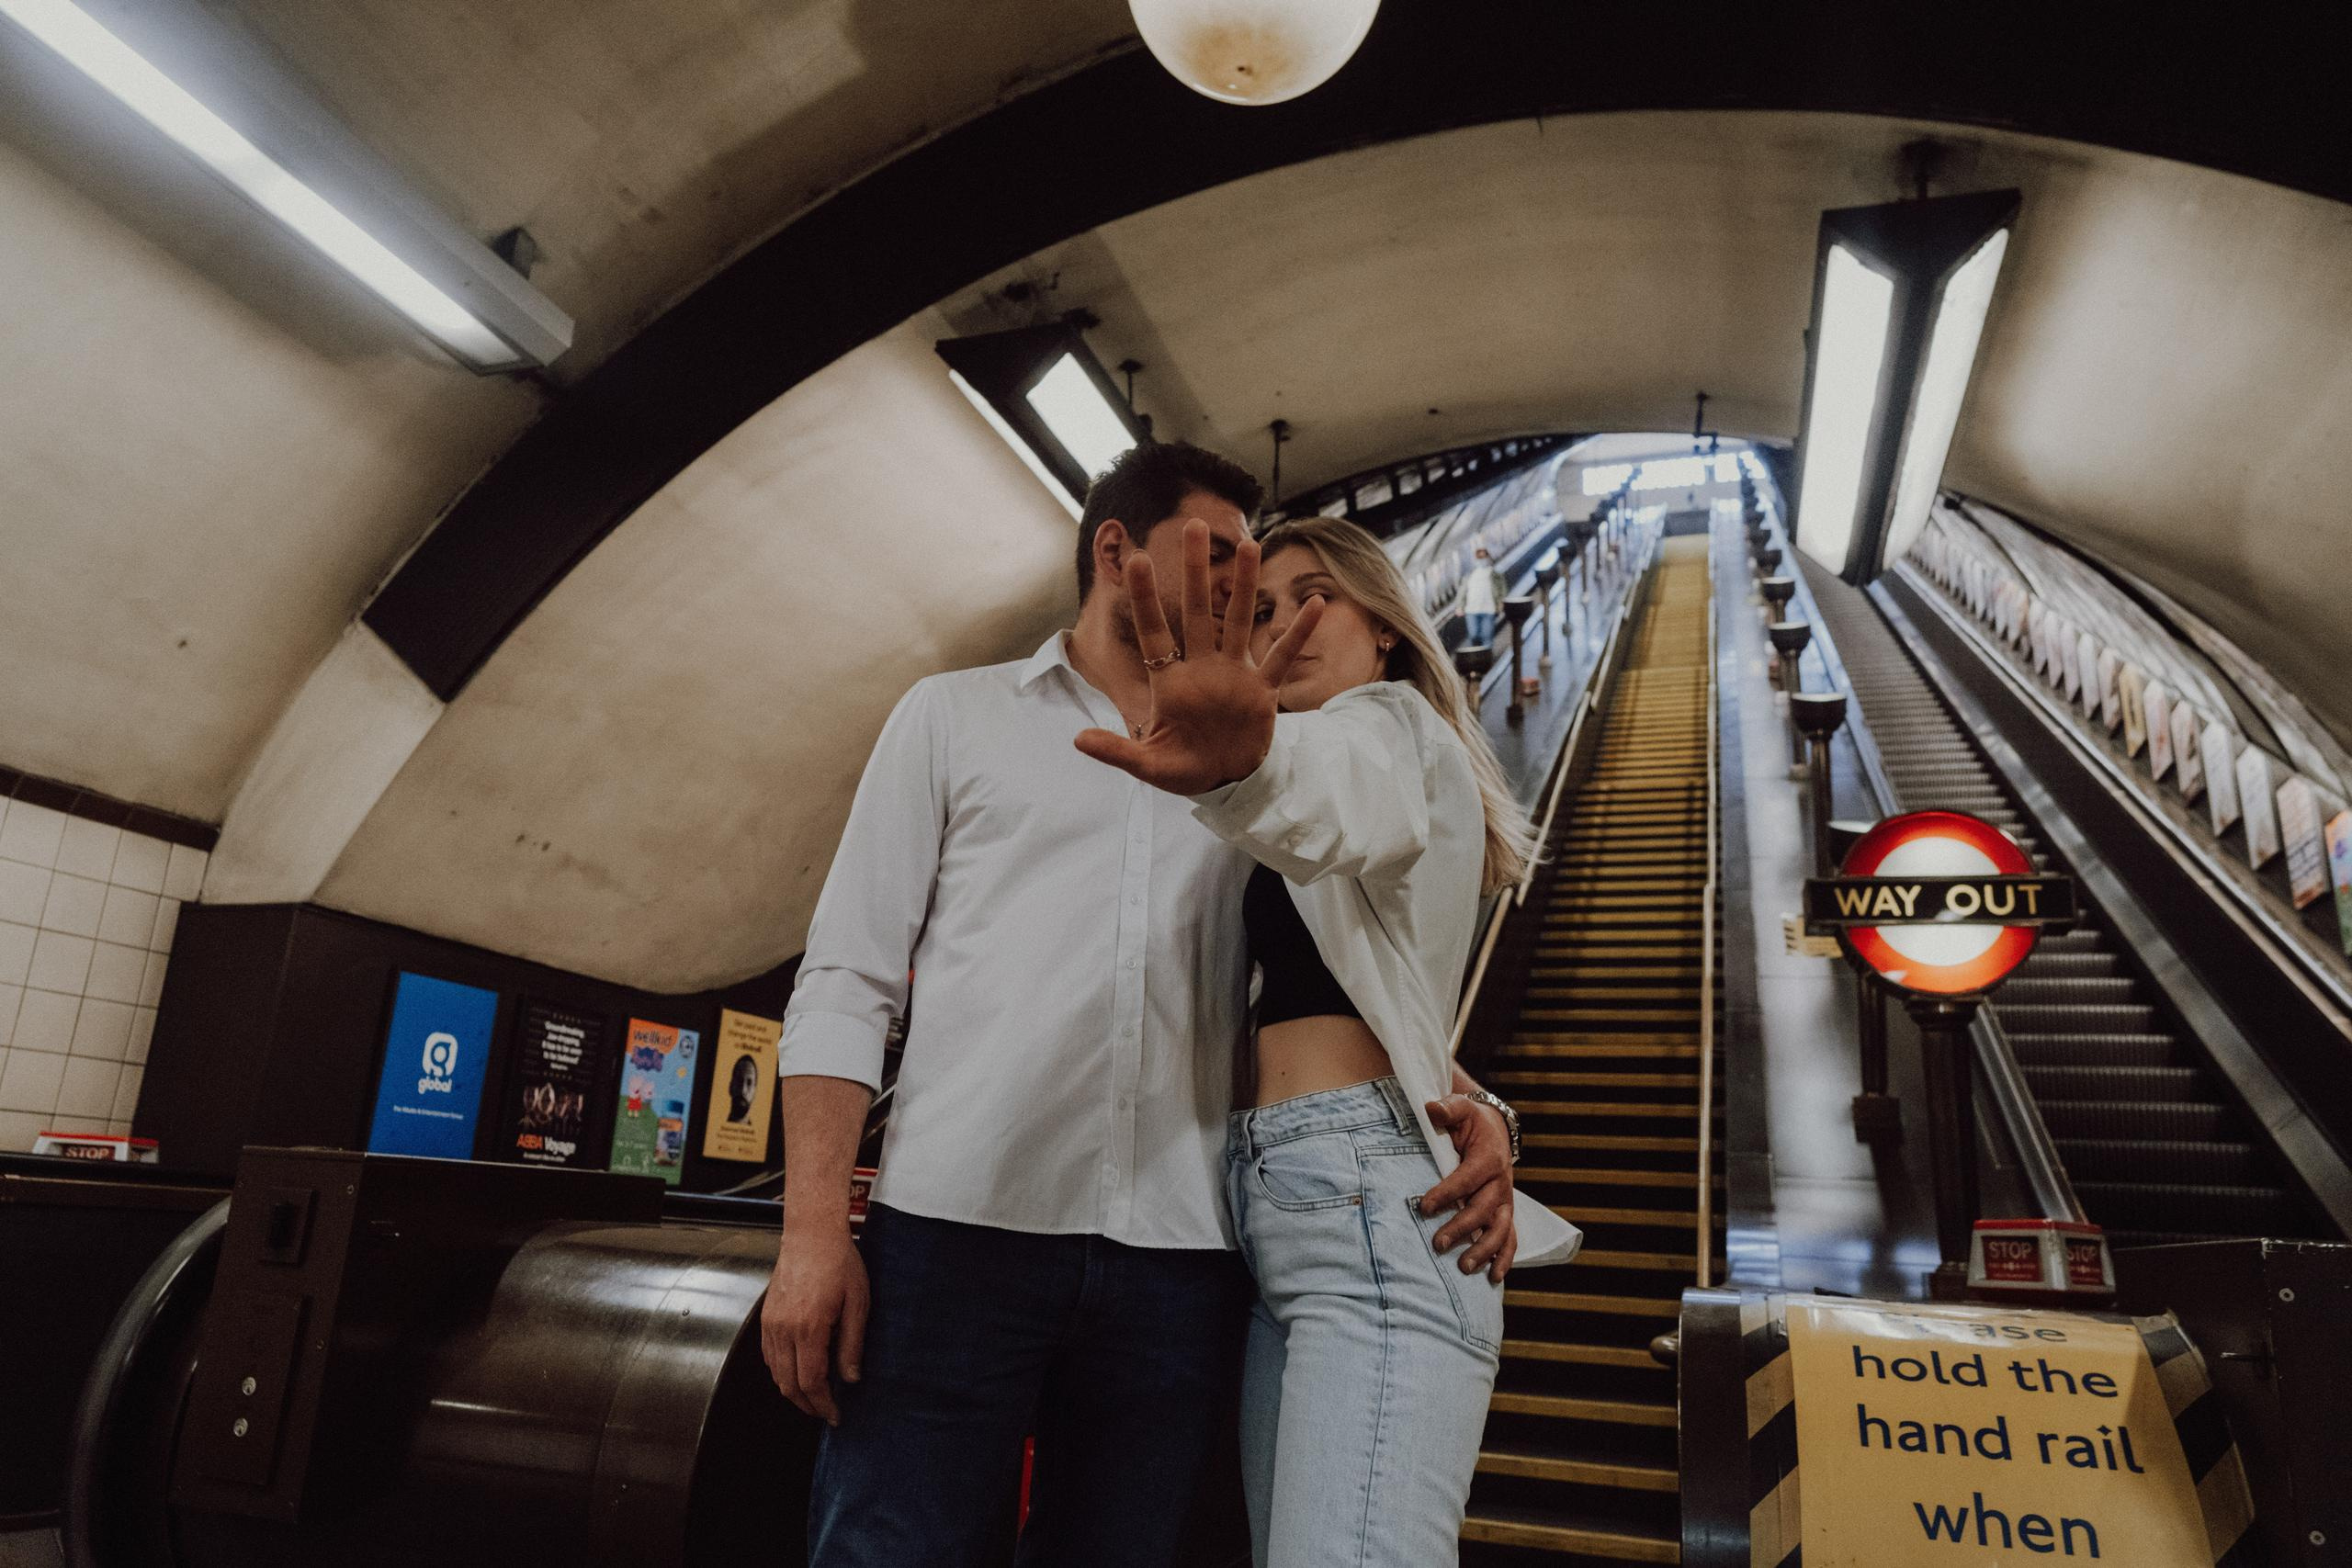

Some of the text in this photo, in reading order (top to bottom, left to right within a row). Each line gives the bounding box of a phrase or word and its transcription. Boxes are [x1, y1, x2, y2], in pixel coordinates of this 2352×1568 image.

[1835, 885, 2042, 917] WAY OUT
[418, 1076, 452, 1095] global
[65, 1146, 108, 1159] STOP
[516, 1134, 576, 1156] ABBA Voyage
[1988, 1241, 2032, 1259] STOP
[2066, 1245, 2097, 1262] STOP
[1852, 1345, 2120, 1398] hold the
[1857, 1403, 2146, 1474] hand rail
[1914, 1491, 2101, 1559] when
